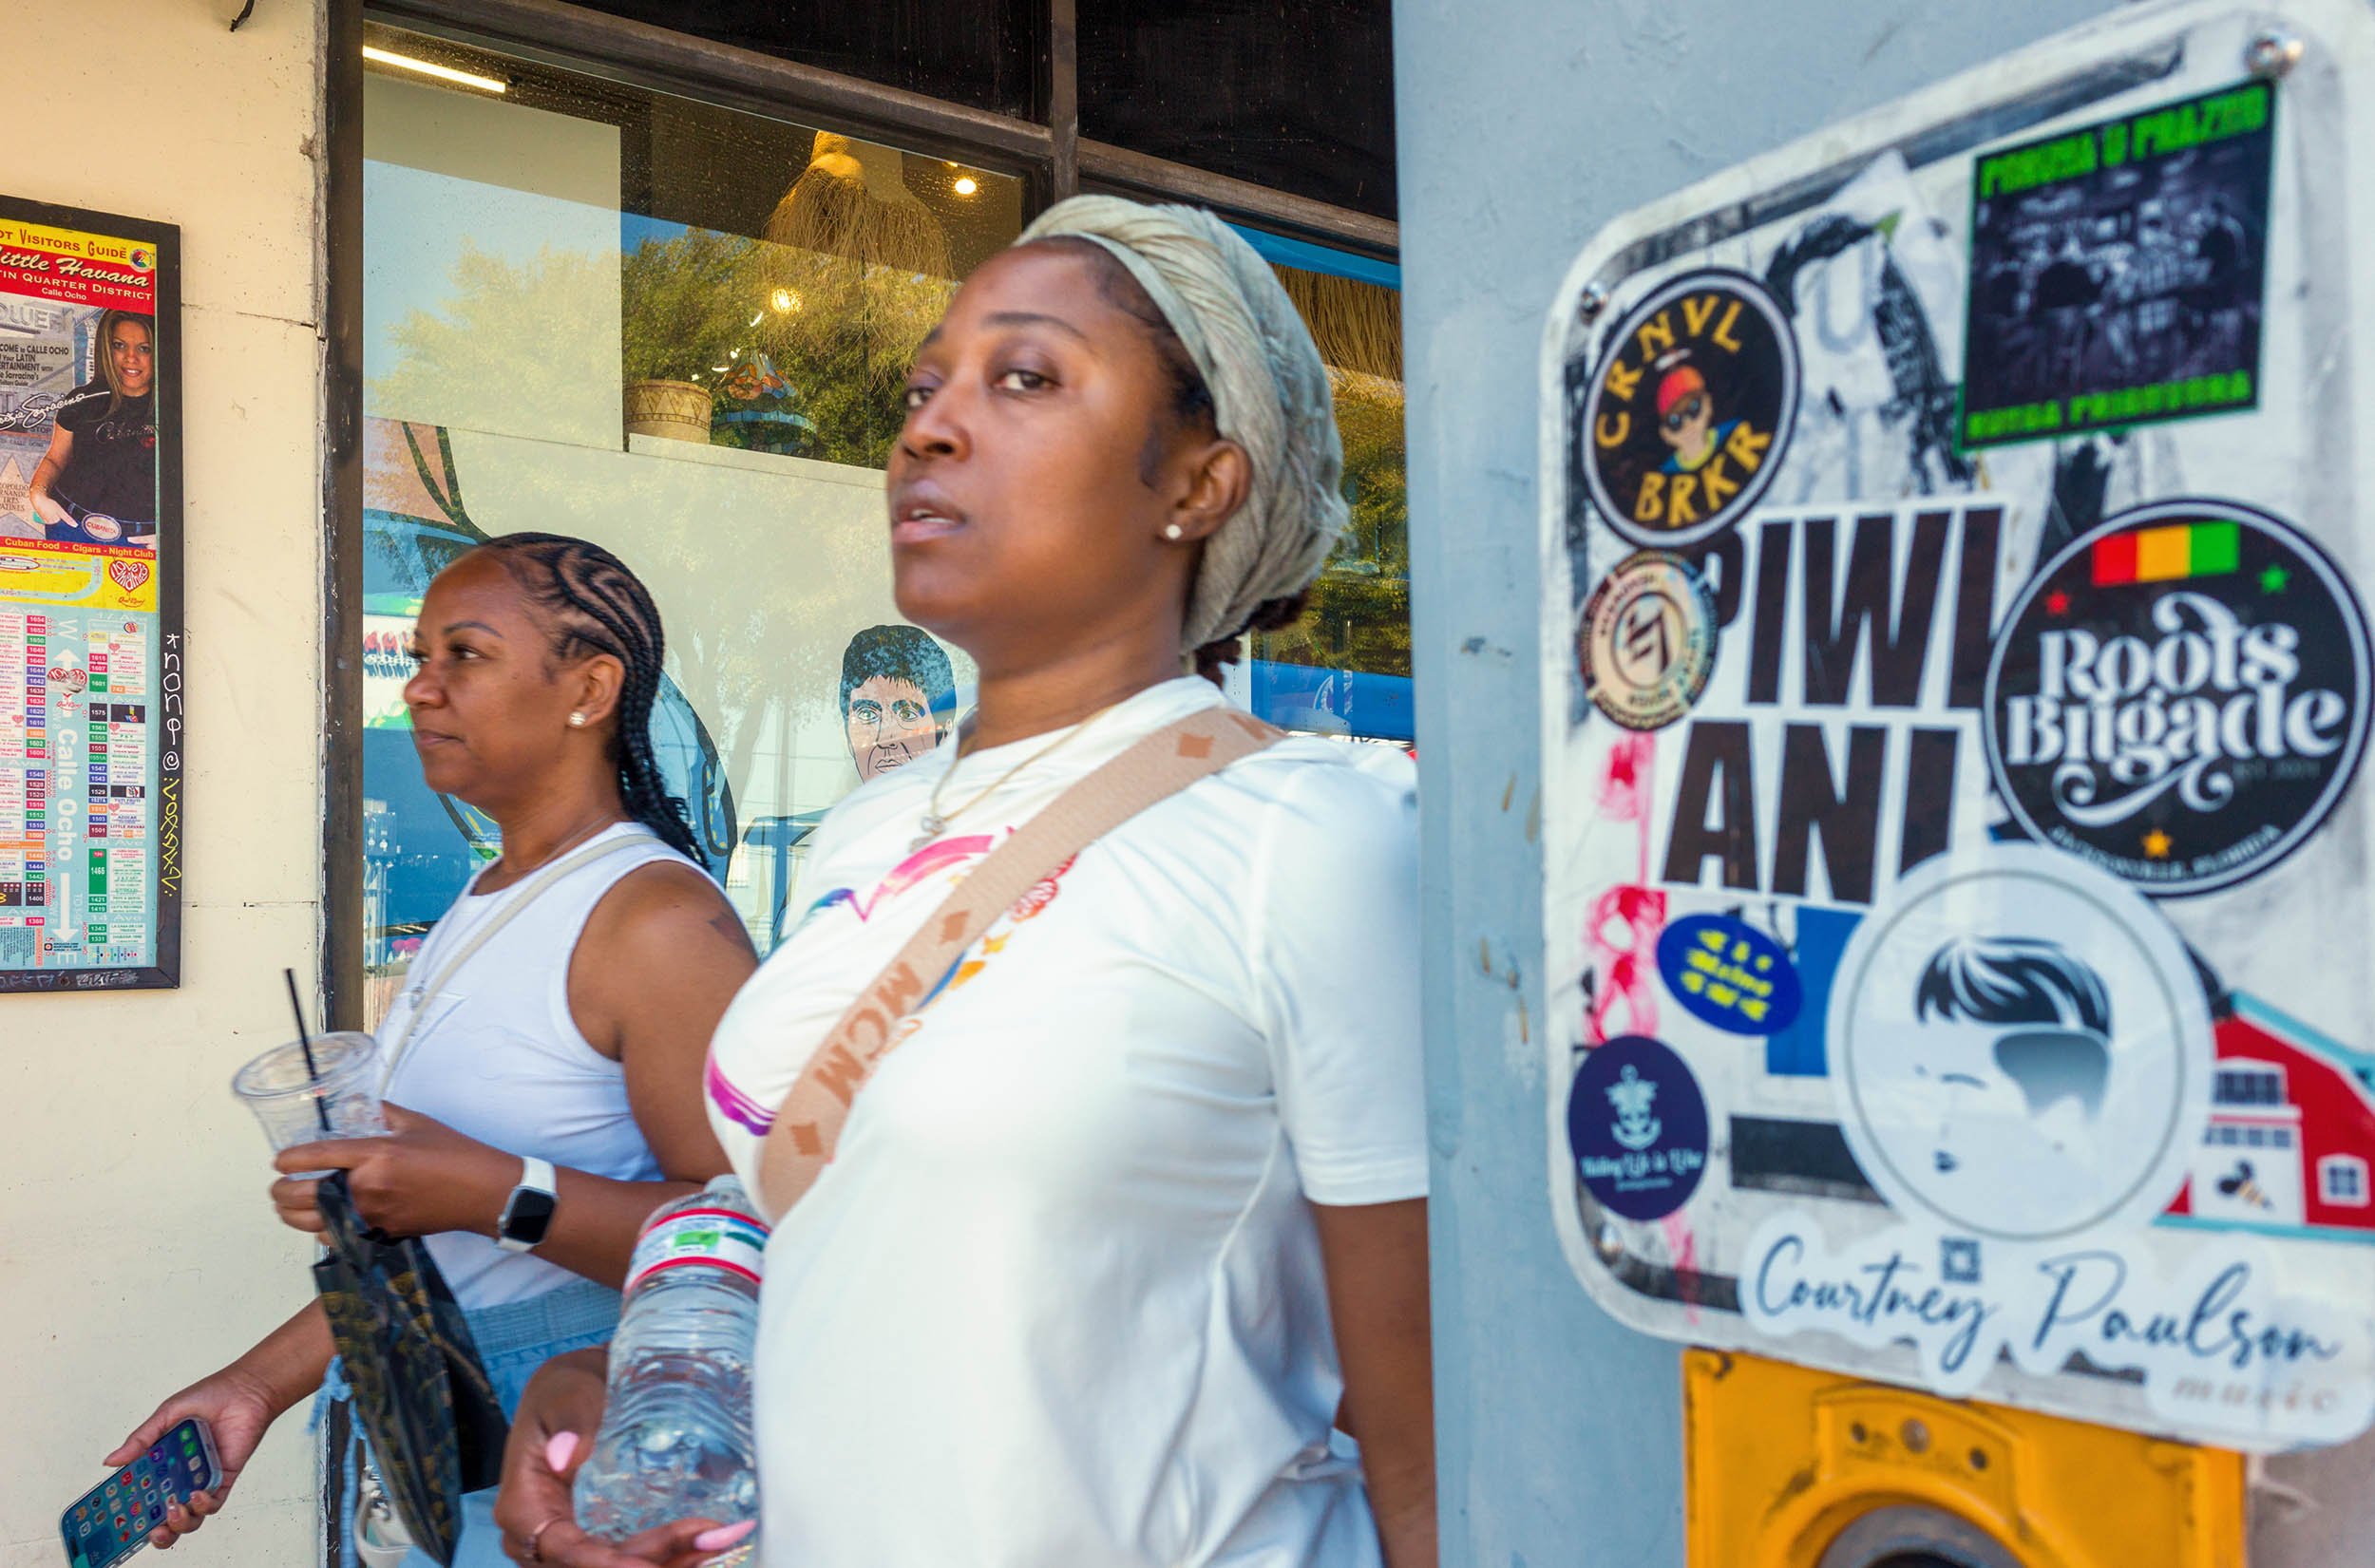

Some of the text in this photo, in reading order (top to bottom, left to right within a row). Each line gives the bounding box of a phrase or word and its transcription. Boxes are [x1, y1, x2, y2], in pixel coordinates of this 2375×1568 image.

[55, 257, 149, 287] Havana
[87, 240, 126, 258] GUIDE
[23, 273, 86, 291] QUARTER
[92, 284, 152, 300] DISTRICT
[42, 287, 87, 300] Calle Ocho
[16, 353, 36, 362] LATIN
[27, 345, 48, 354] CALLE
[48, 346, 69, 355] OCHO
[1595, 294, 1743, 448] CRNVL
[1633, 420, 1773, 528] BRKR
[5, 538, 154, 558] Cuban Food Cigars Night Club
[2039, 591, 2301, 700] Roots
[57, 728, 78, 790] Calle
[2005, 682, 2346, 788] Brigade
[57, 798, 78, 860] Ocho
[1662, 720, 1963, 907] ANI
[813, 961, 927, 1108] MCM
[1755, 1234, 1996, 1374] Courtney
[2032, 1250, 2343, 1368] Paulson
